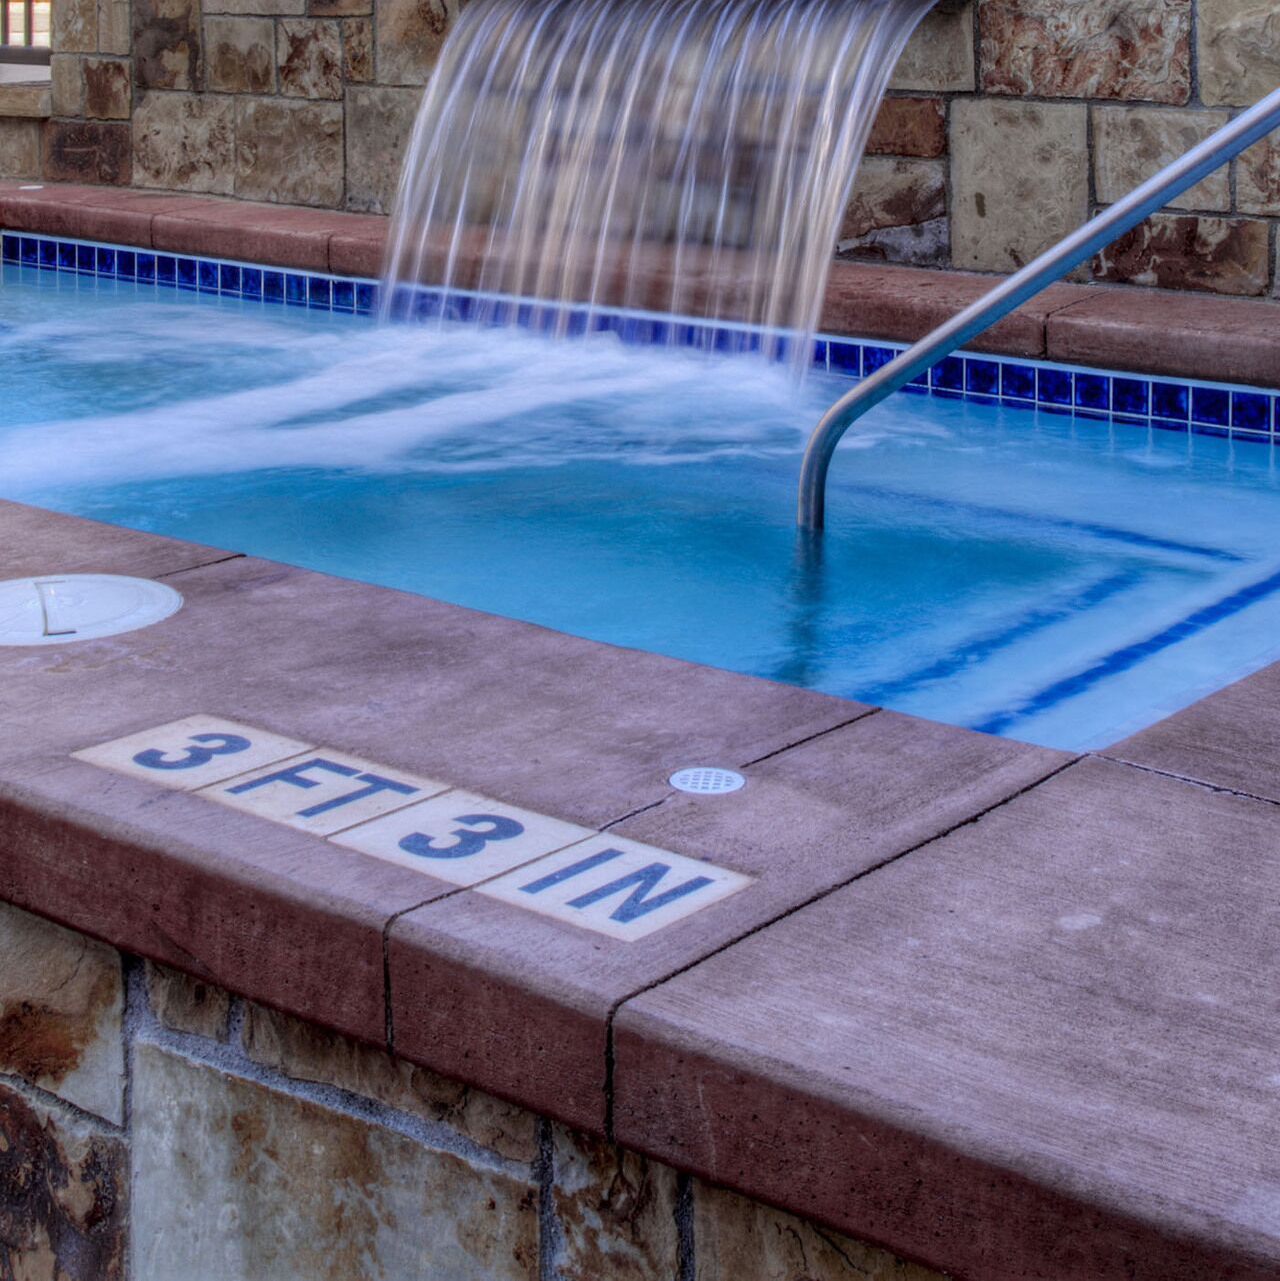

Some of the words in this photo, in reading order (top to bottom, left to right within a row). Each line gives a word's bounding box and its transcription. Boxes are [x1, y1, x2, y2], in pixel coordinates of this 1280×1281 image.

[131, 732, 253, 771] 3
[224, 757, 421, 819] FT
[397, 814, 526, 860] 3
[516, 847, 717, 925] IN
